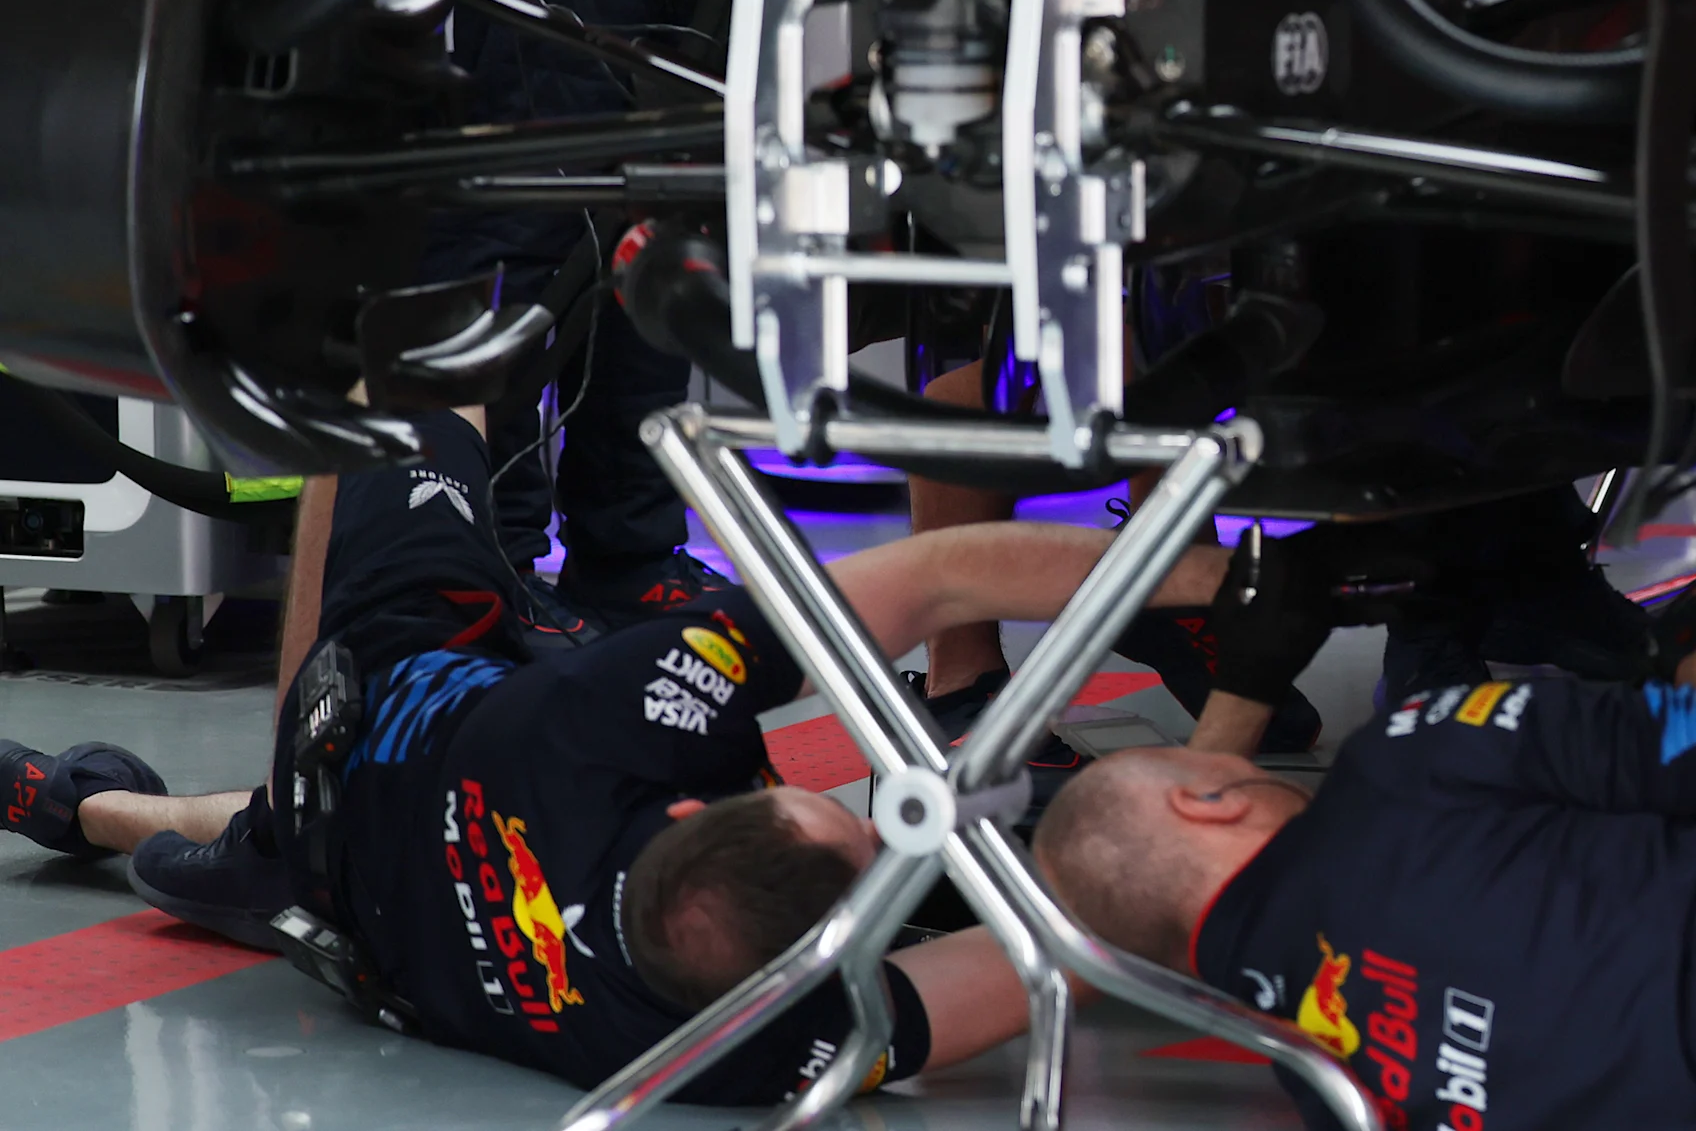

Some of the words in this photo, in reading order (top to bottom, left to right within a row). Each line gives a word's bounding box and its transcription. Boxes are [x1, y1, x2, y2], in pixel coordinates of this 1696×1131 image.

[656, 648, 735, 706] ROKT
[444, 790, 488, 951] Mobil
[1435, 1042, 1487, 1131] obil
